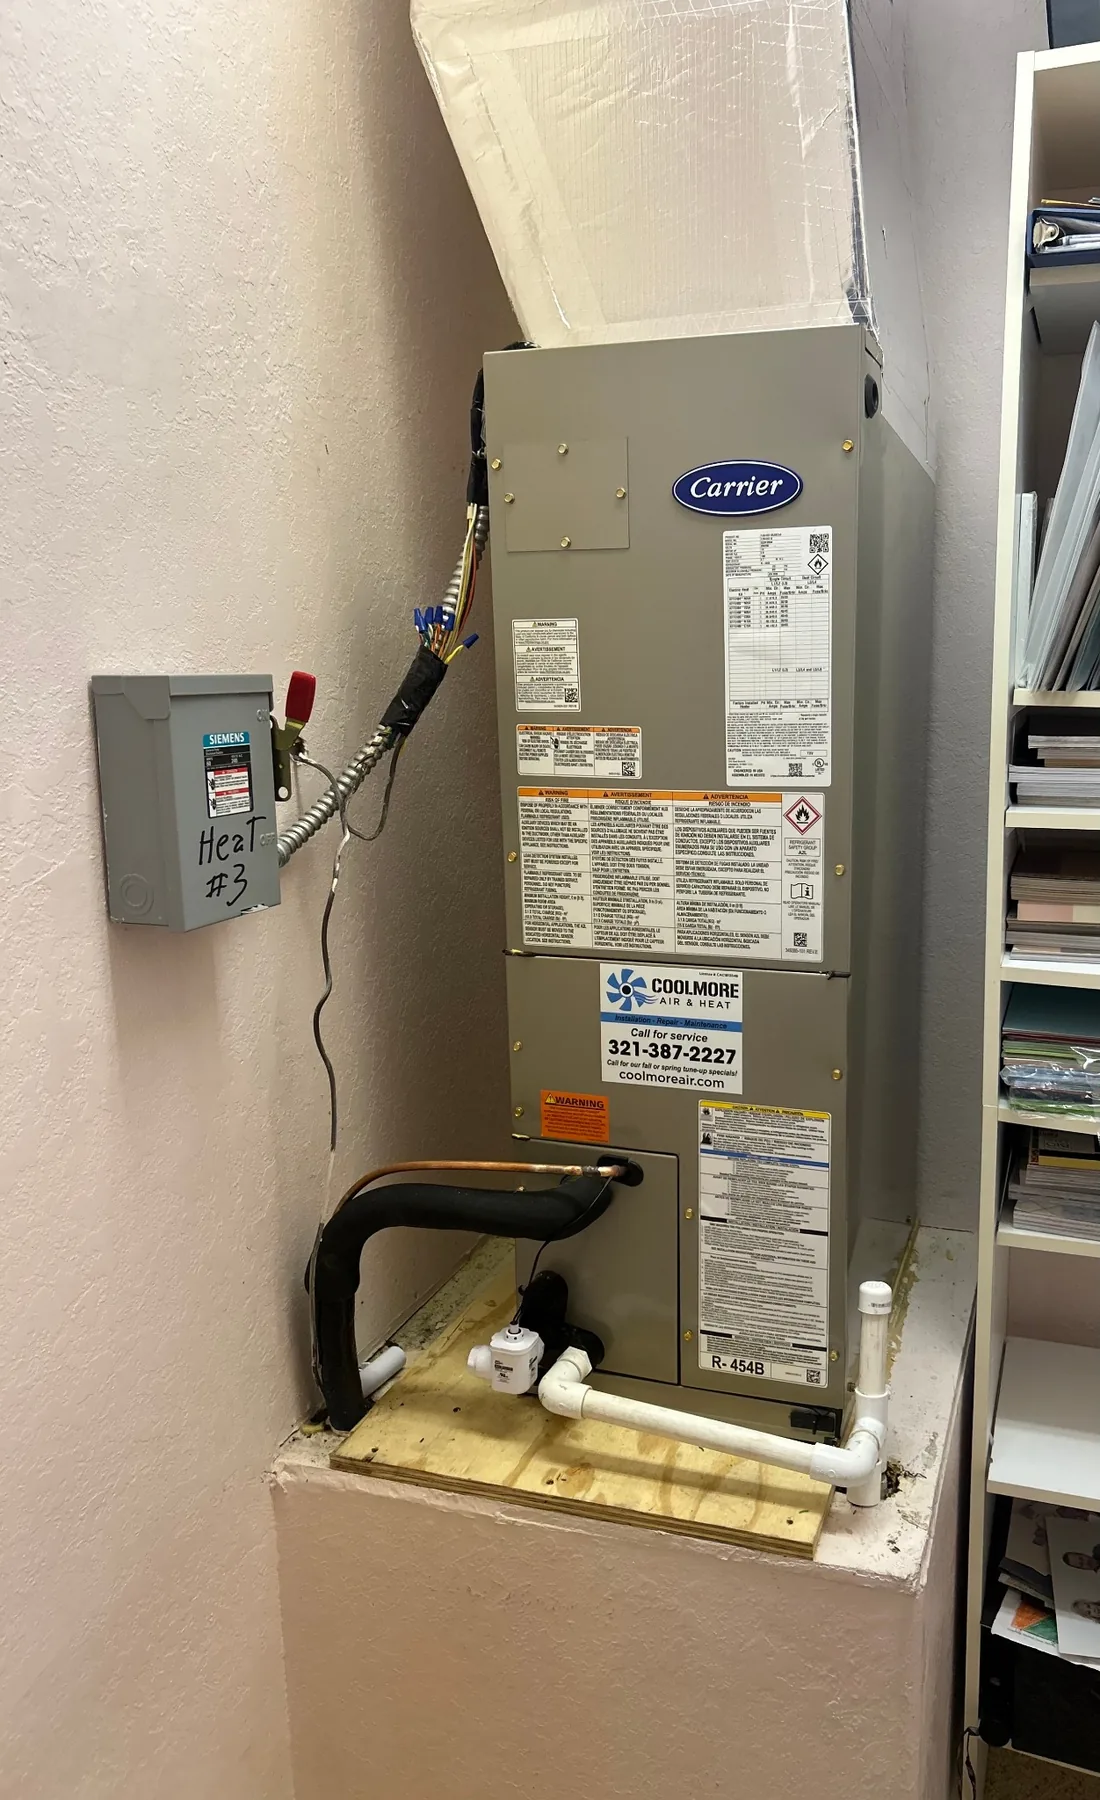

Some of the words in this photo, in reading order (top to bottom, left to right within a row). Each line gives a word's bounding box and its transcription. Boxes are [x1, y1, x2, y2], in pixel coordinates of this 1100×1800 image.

[690, 476, 783, 498] Carrier
[210, 733, 244, 744] SIEMENS
[206, 864, 248, 906] #3
[652, 978, 738, 998] COOLMORE
[660, 997, 680, 1006] AIR
[700, 1000, 731, 1009] HEAT
[615, 1015, 650, 1023] Installation
[657, 1018, 679, 1026] Repair
[684, 1020, 727, 1029] Maintenance
[631, 1028, 650, 1038] Call
[653, 1030, 668, 1039] for
[671, 1032, 708, 1042] service
[608, 1040, 736, 1065] 321-387-2227
[661, 1065, 681, 1073] spring
[683, 1067, 707, 1075] tune-up
[708, 1069, 738, 1077] specials!
[619, 1070, 724, 1088] coolmoreair.com
[555, 1096, 604, 1108] WARNING
[730, 1359, 764, 1375] 454B
